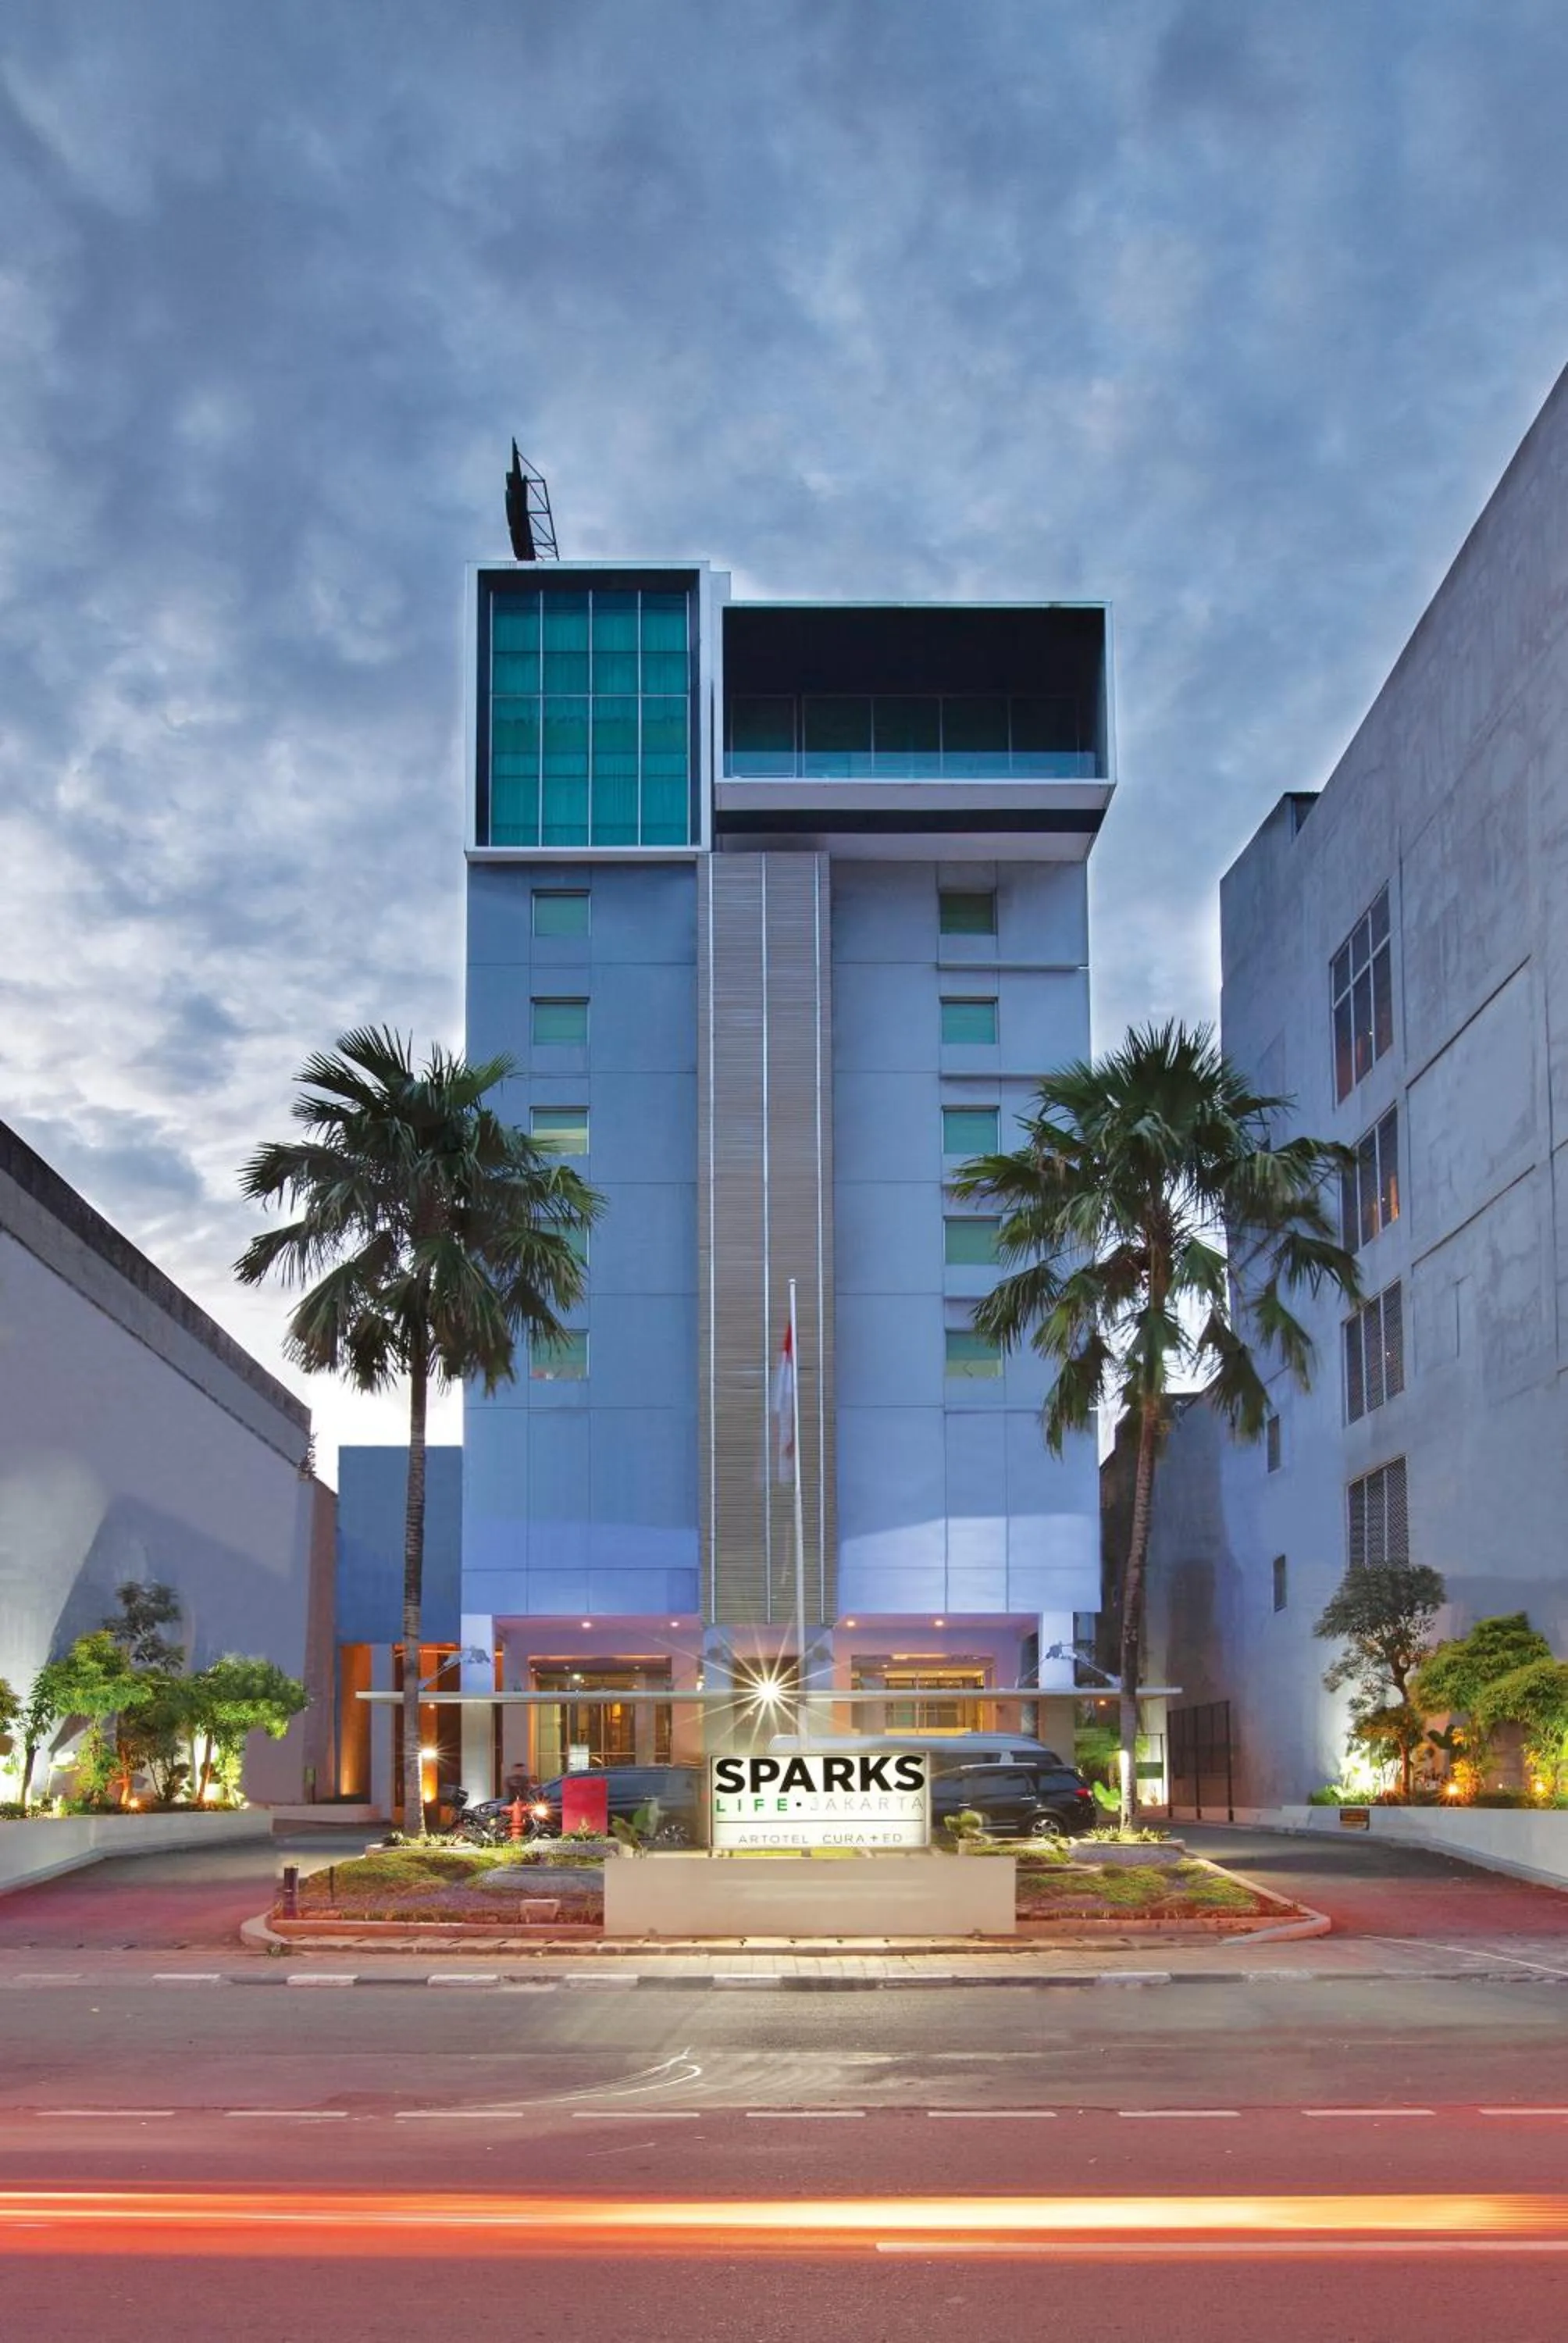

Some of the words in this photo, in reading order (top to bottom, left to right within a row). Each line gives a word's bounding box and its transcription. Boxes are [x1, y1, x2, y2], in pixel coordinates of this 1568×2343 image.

[715, 1756, 925, 1794] SPARKS
[715, 1798, 789, 1812] LIFE
[810, 1796, 924, 1811] JAKARTA
[738, 1834, 808, 1844] ARTOTEL
